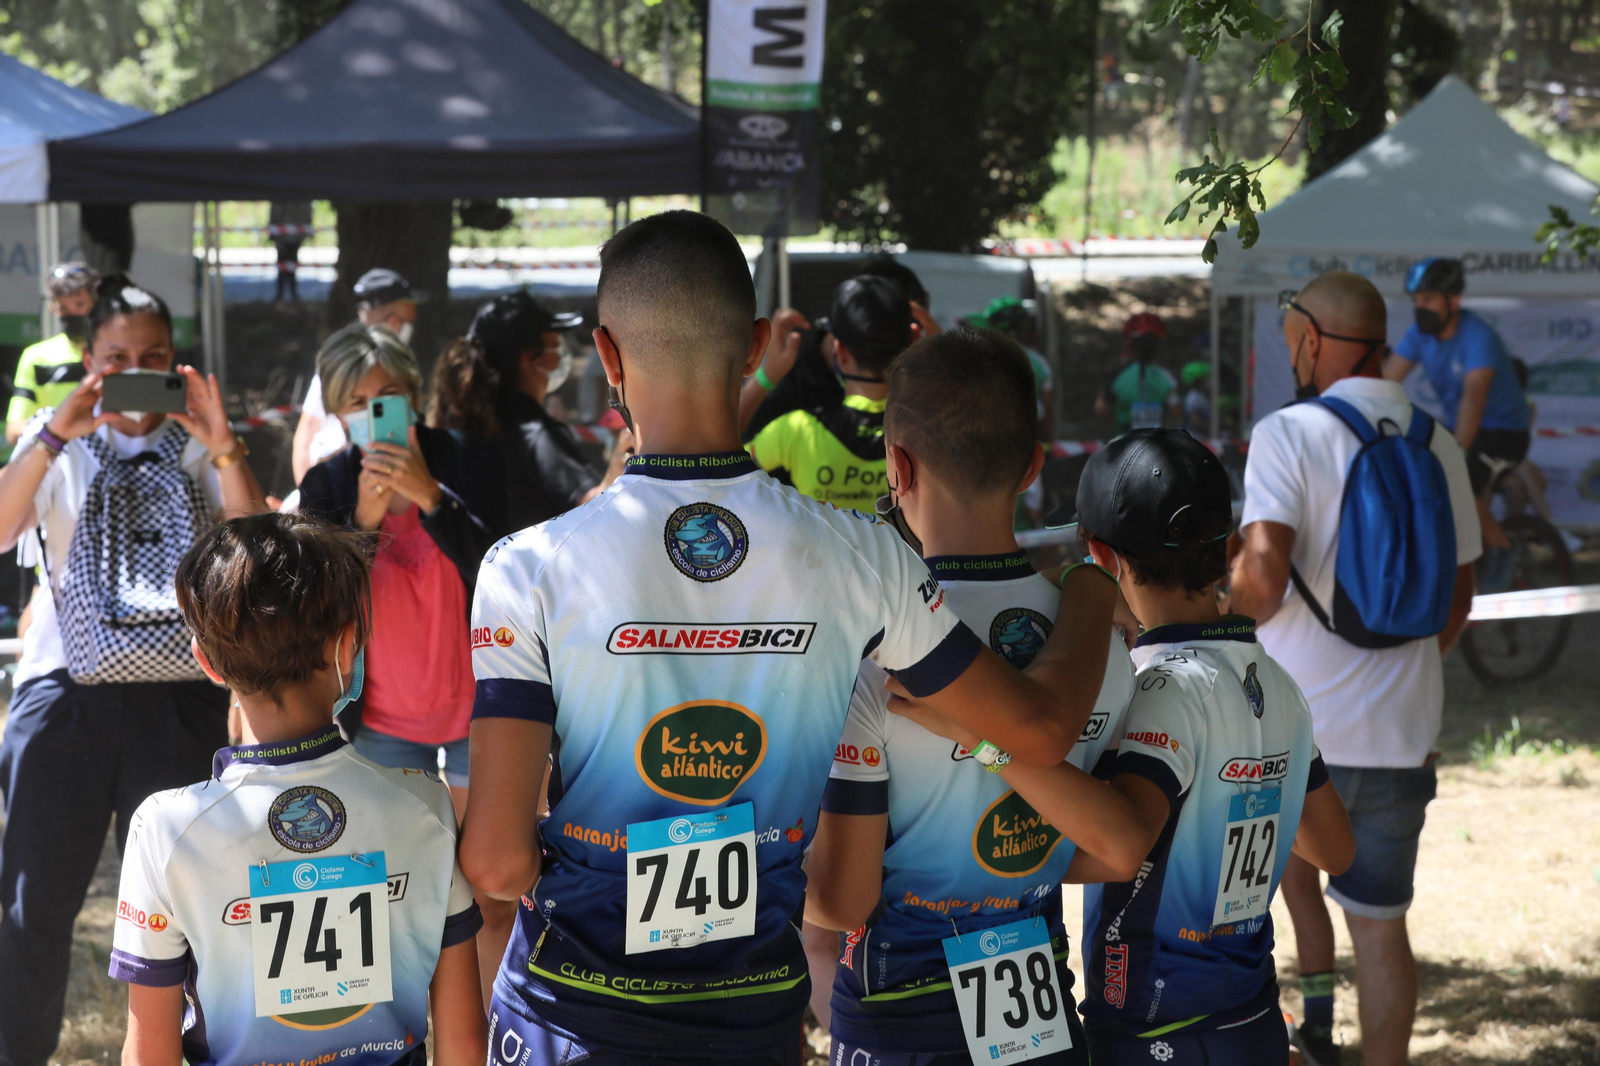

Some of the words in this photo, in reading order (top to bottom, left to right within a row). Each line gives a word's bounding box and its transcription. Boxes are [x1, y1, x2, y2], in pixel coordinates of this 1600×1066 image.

[627, 456, 646, 467] club
[649, 457, 695, 468] ciclista
[677, 506, 709, 521] CICLISTA
[710, 507, 743, 541] RIBADUMIA
[672, 549, 695, 574] escola
[696, 567, 708, 578] de
[710, 549, 742, 577] ciclismo
[935, 560, 960, 571] club
[963, 560, 1003, 571] ciclista
[616, 628, 806, 649] SALNESBICI
[1202, 627, 1224, 637] club
[661, 726, 748, 755] kiwi
[231, 750, 254, 760] club
[257, 746, 298, 758] ciclista
[661, 755, 743, 780] atlántico
[278, 789, 308, 807] CICLISTA
[277, 829, 301, 849] escola
[302, 842, 313, 850] de
[315, 822, 342, 849] ciclismo
[694, 827, 716, 835] Galego
[992, 832, 1048, 858] atlántico
[1223, 820, 1275, 893] 742
[320, 866, 345, 874] Ciclismo
[320, 872, 343, 881] Galego
[636, 841, 749, 923] 740
[260, 892, 374, 979] 741
[560, 962, 606, 986] CLUB
[293, 986, 315, 995] XUNTA
[303, 991, 329, 1000] GALICIA
[958, 951, 1058, 1039] 738
[340, 1046, 356, 1058] de
[999, 1040, 1016, 1050] XUNTA
[1008, 1044, 1027, 1054] GALICIA
